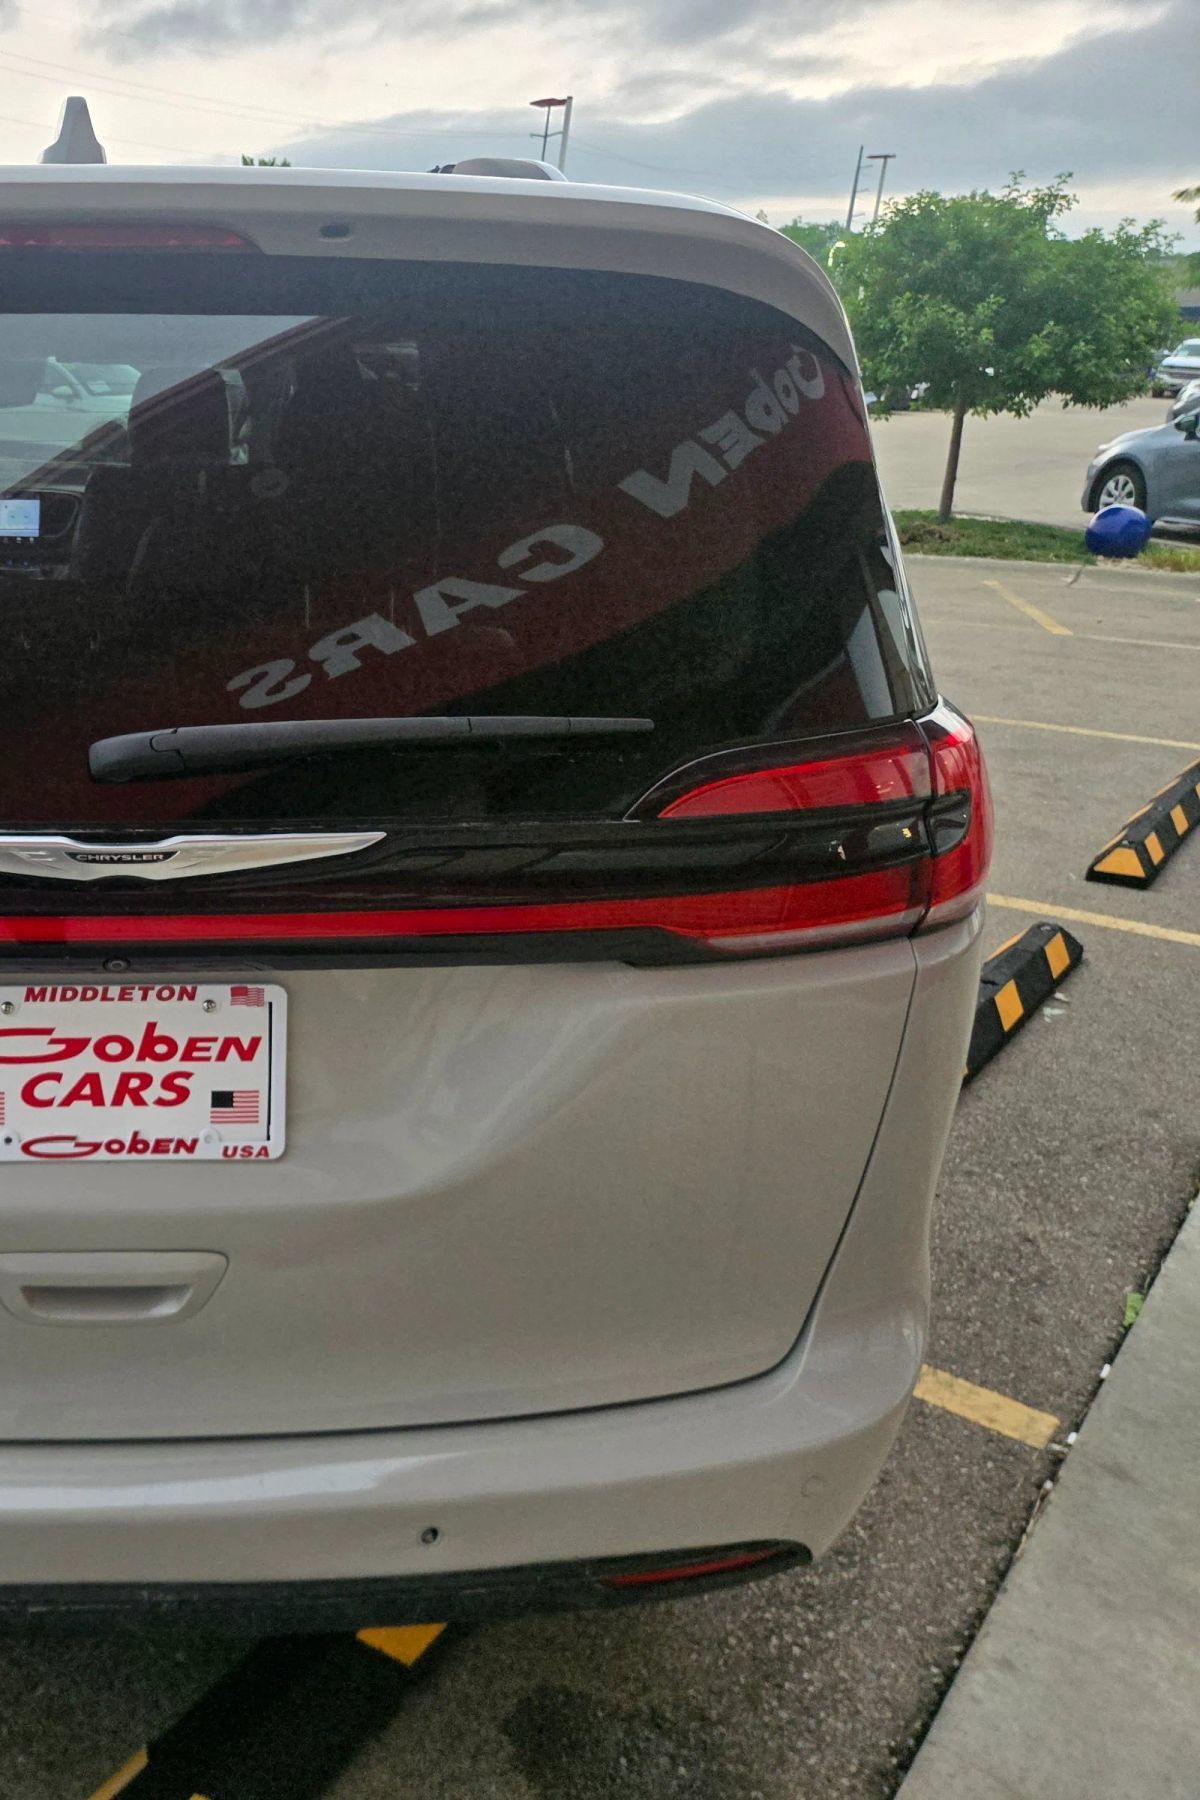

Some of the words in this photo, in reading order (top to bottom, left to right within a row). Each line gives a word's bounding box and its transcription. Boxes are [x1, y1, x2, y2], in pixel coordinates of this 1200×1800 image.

[23, 985, 198, 1003] MIDDLETON
[20, 1071, 195, 1108] CARS
[222, 1144, 270, 1159] USA
